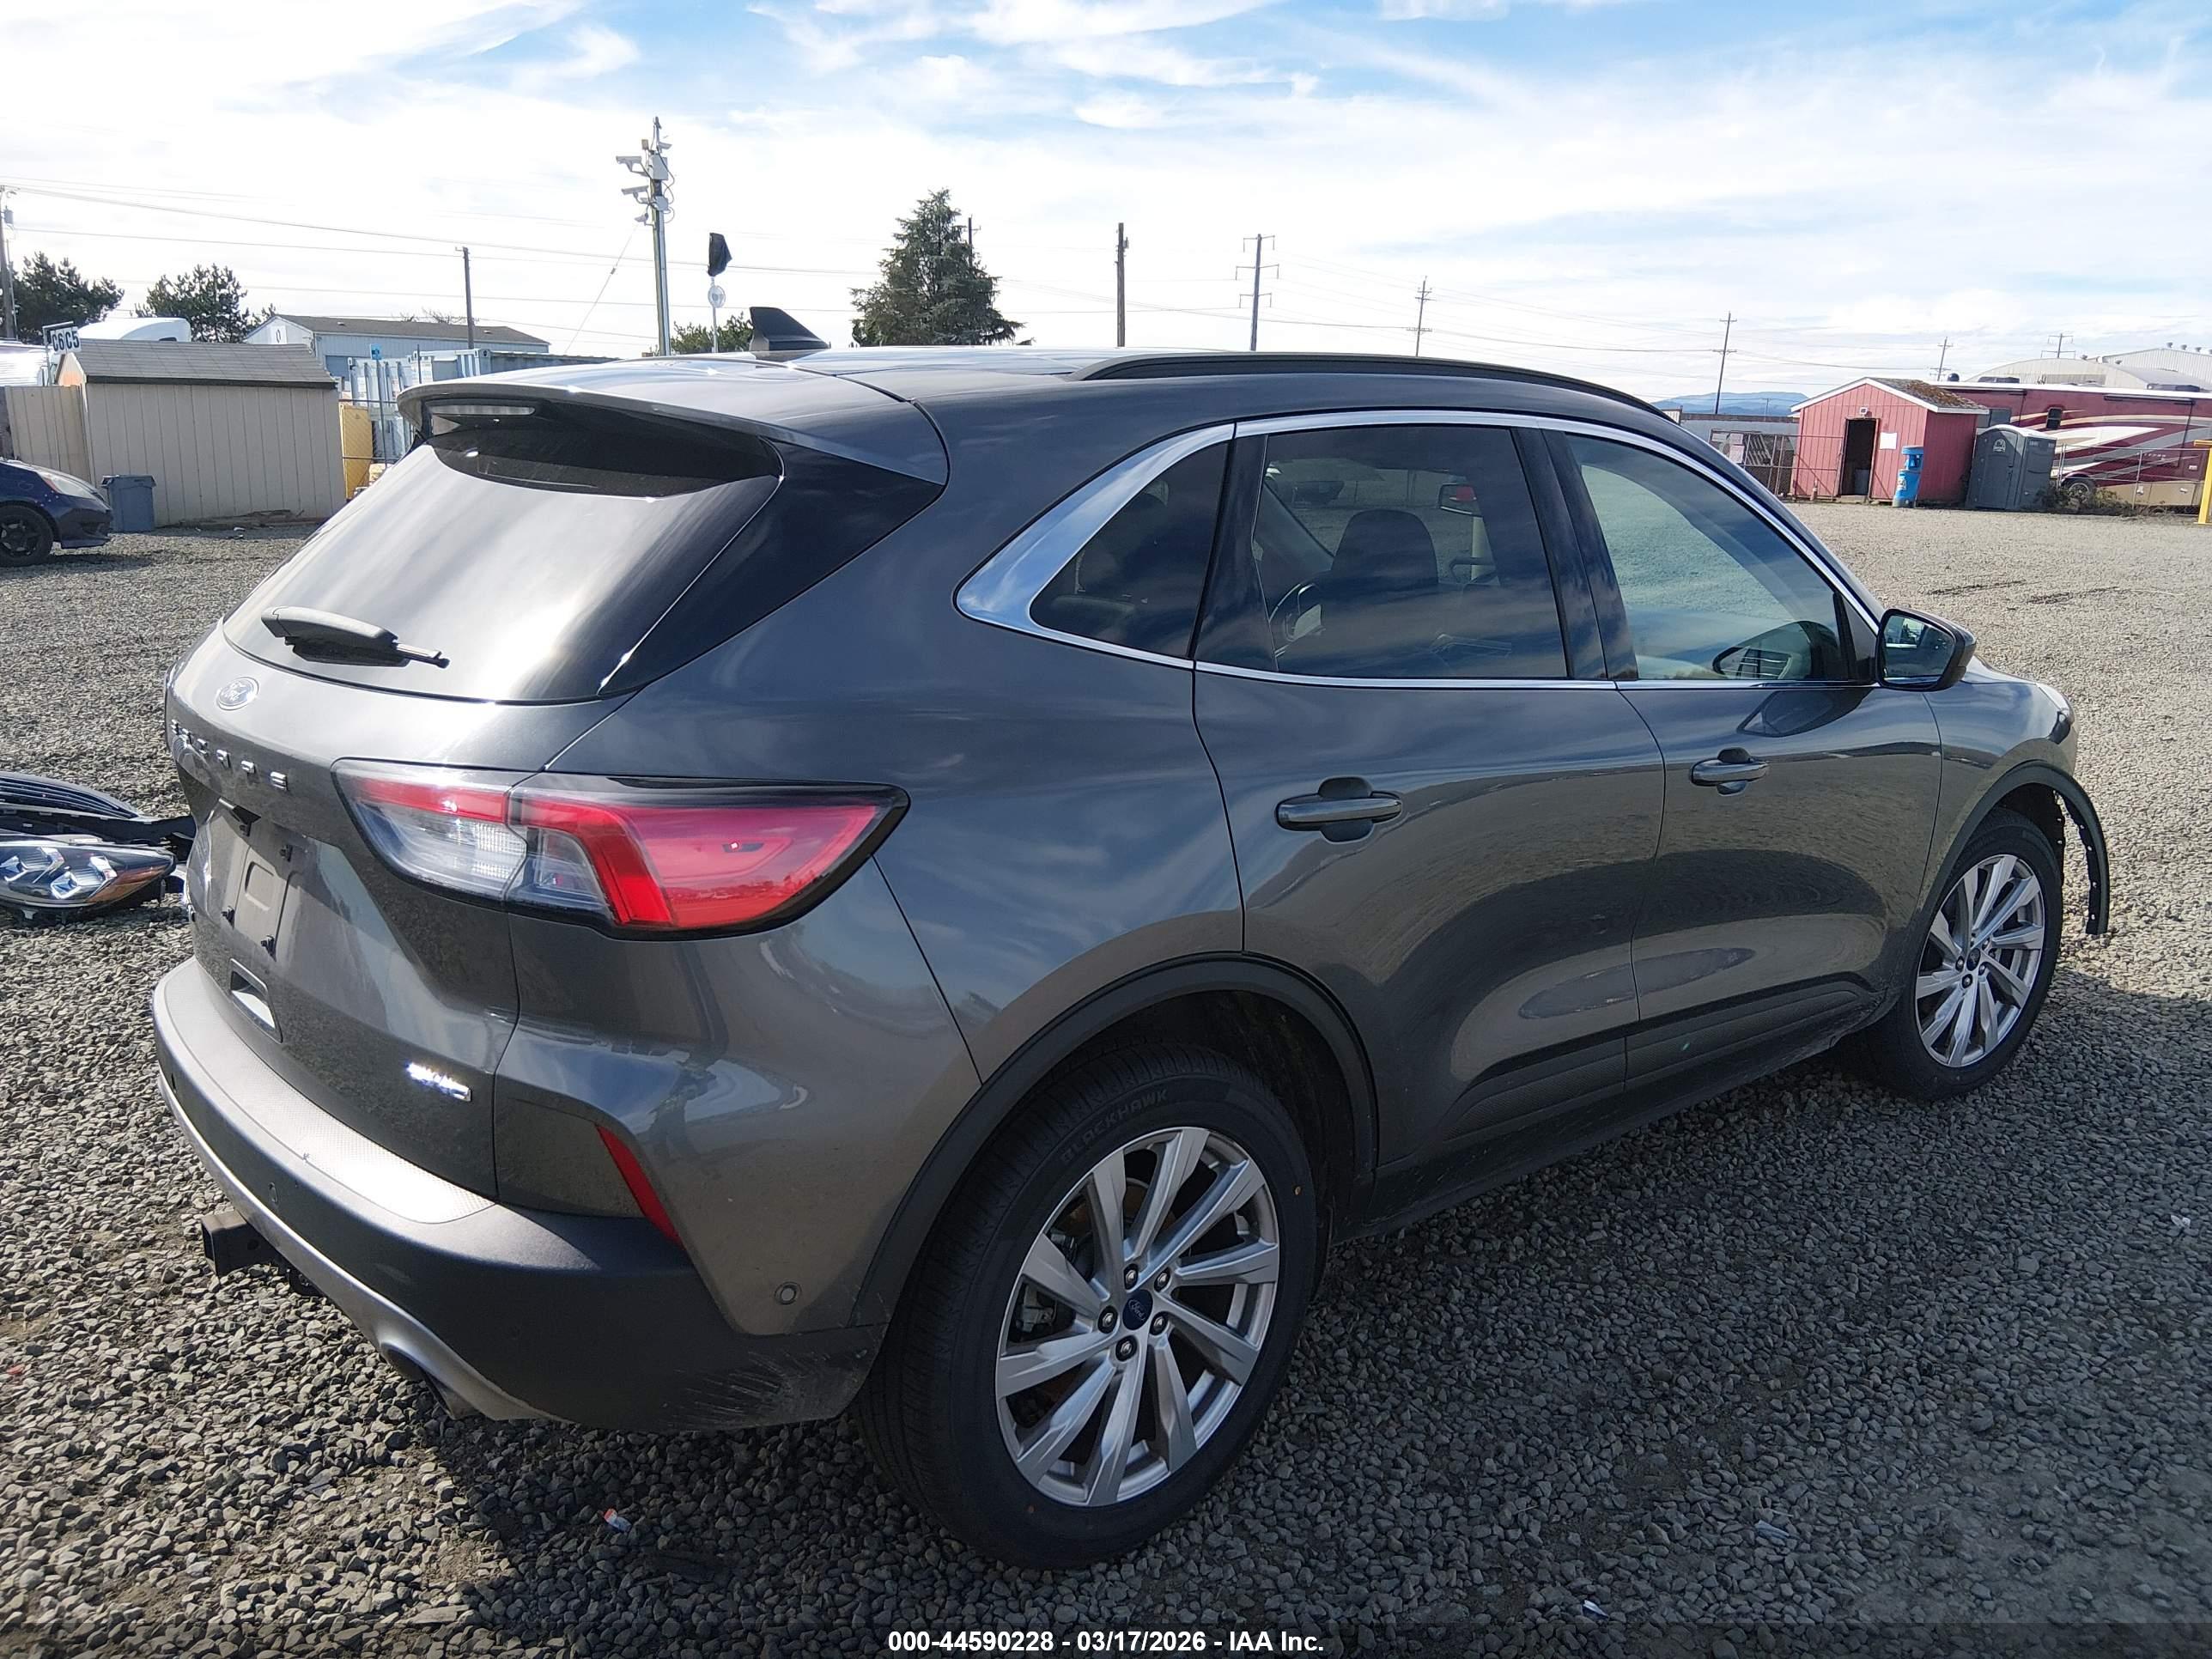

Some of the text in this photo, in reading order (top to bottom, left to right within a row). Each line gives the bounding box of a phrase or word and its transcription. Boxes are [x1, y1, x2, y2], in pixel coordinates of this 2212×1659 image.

[52, 330, 80, 352] C6 C5
[1060, 1089, 1168, 1162] BLACKHAWK
[1127, 1298, 1146, 1322] Ford
